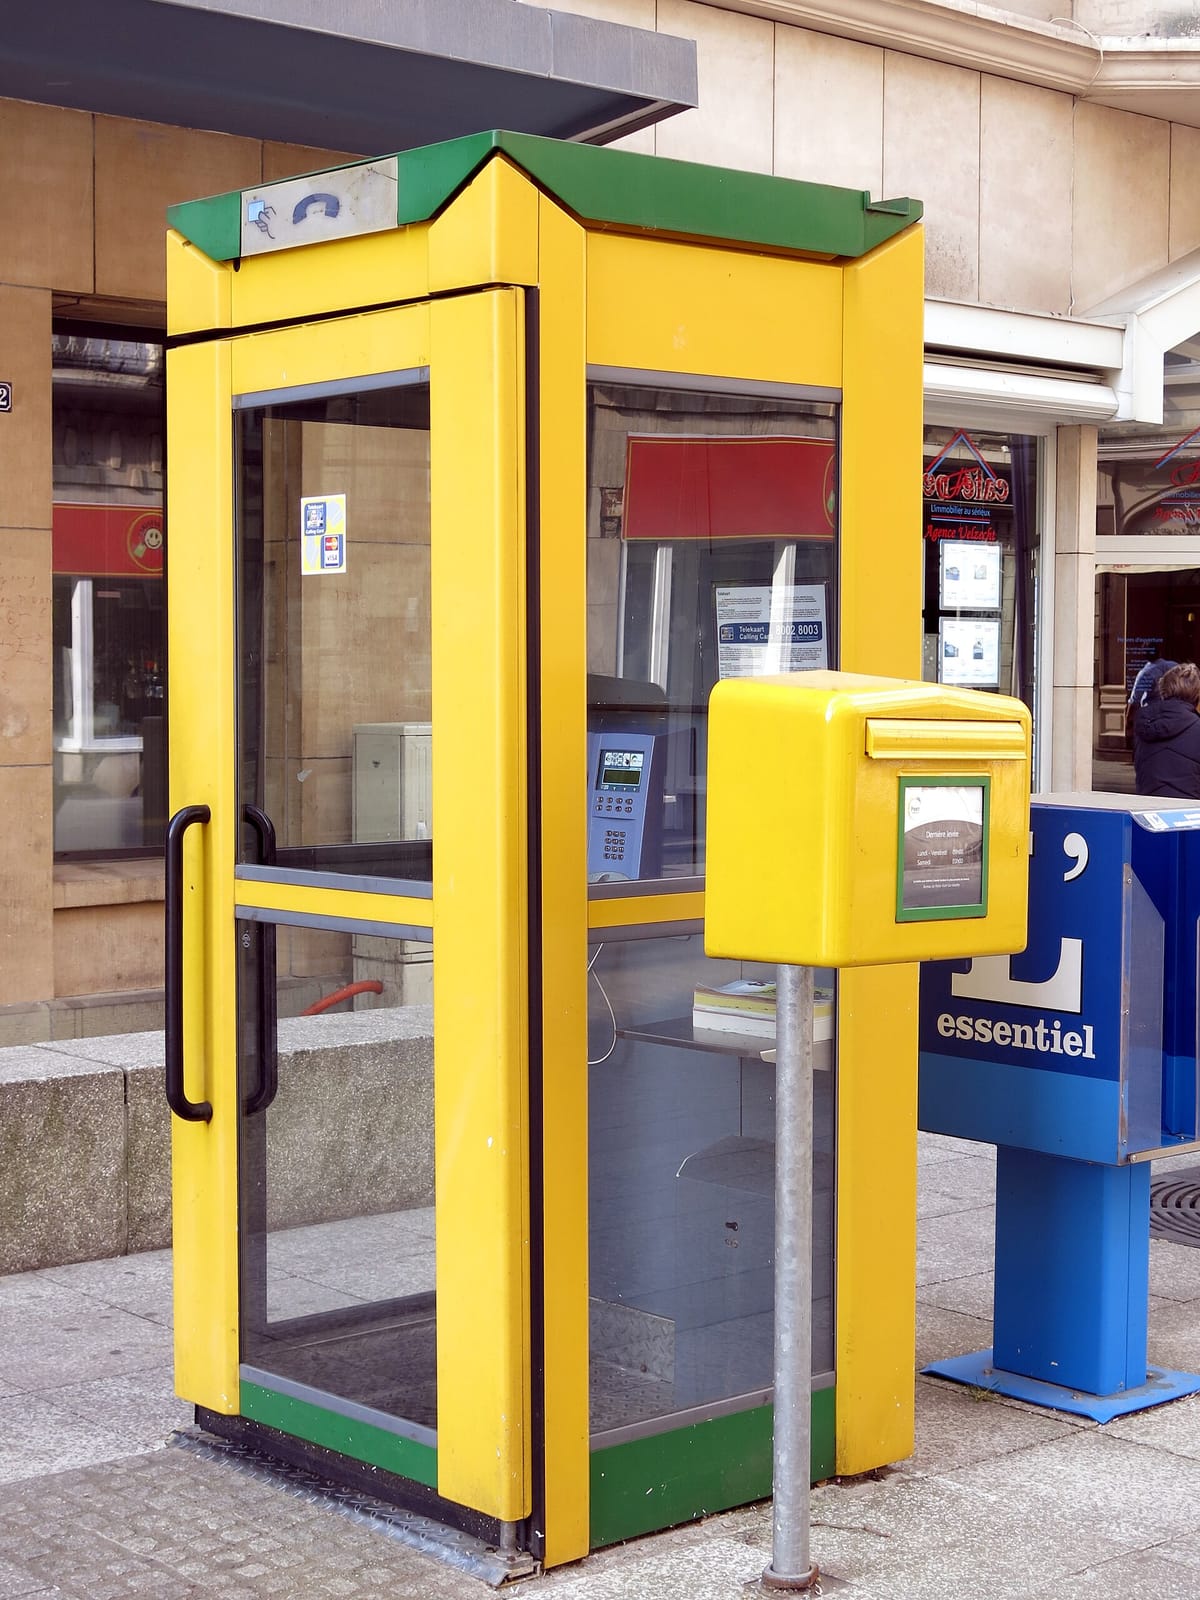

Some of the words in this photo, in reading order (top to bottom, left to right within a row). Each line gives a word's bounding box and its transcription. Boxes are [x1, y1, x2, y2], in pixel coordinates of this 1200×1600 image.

[931, 504, 963, 515] L'immobilier
[971, 506, 991, 517] sérieux
[924, 524, 957, 542] Agence
[739, 625, 765, 633] Telekaart
[776, 624, 796, 635] 8002
[798, 624, 819, 635] 8003
[739, 633, 759, 641] Calling
[937, 1013, 1096, 1059] essentiel
